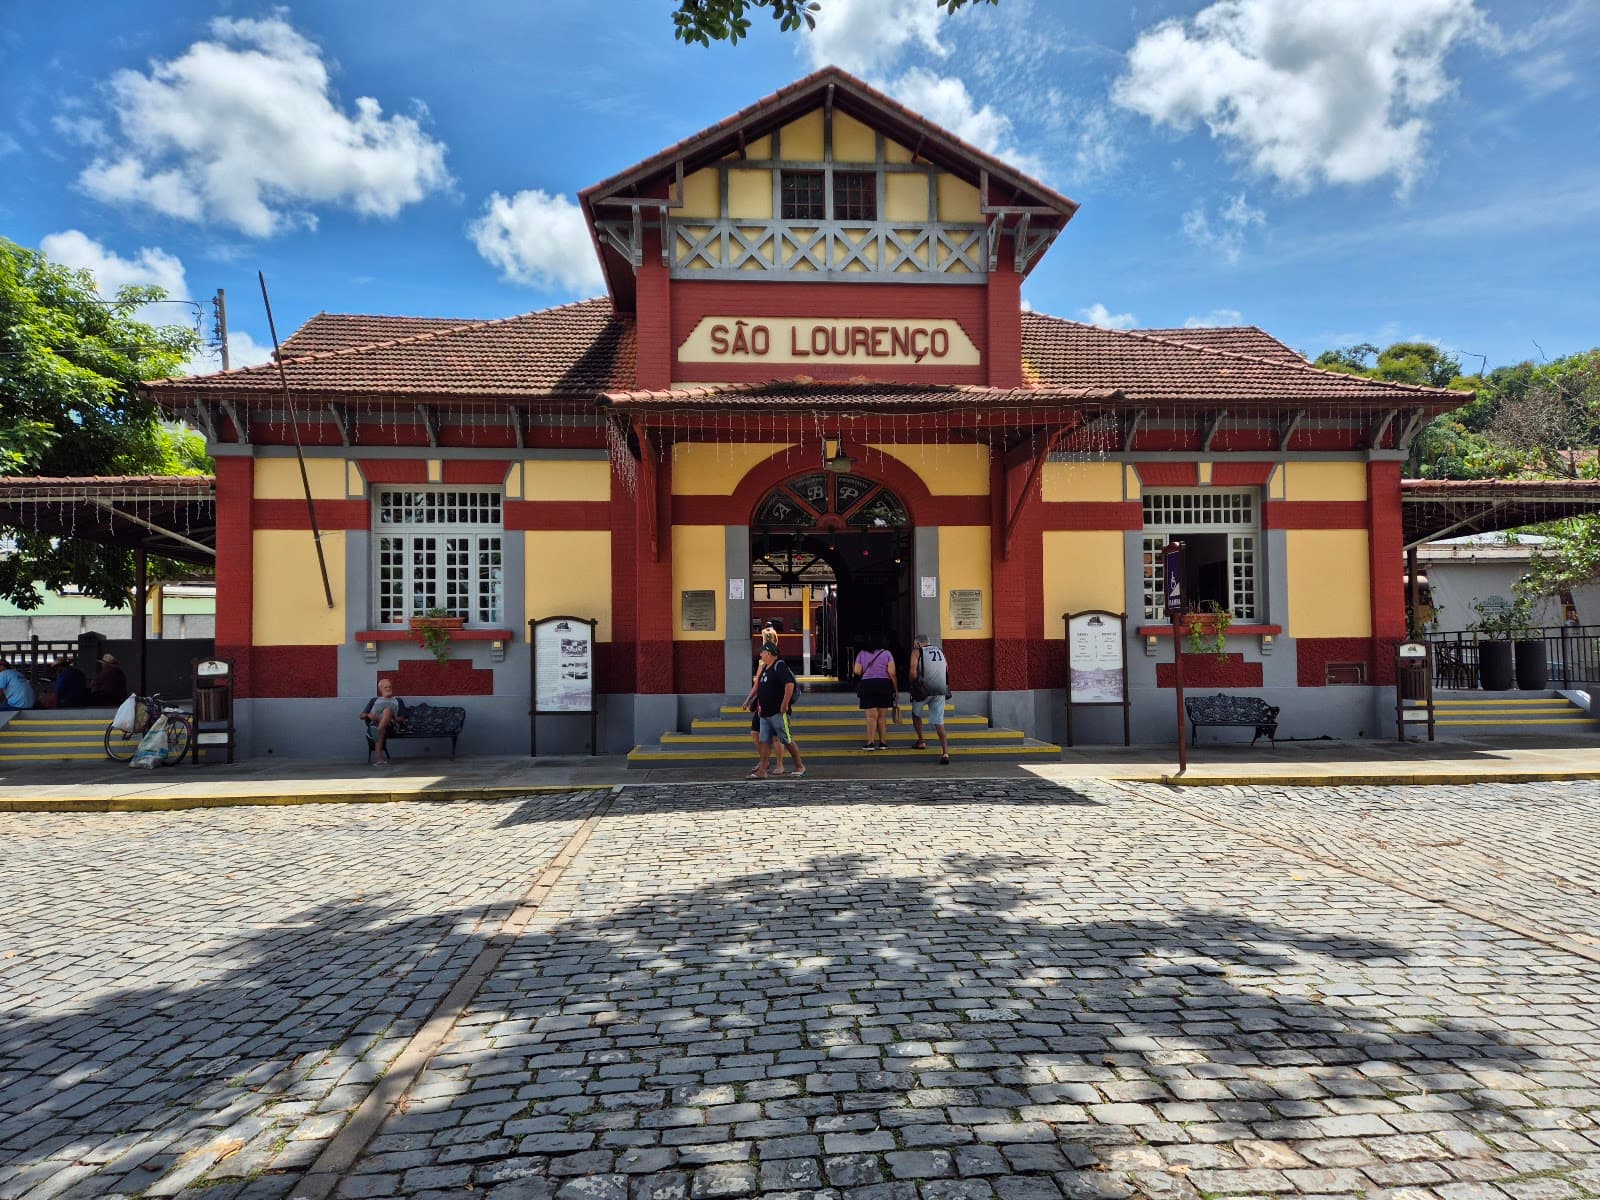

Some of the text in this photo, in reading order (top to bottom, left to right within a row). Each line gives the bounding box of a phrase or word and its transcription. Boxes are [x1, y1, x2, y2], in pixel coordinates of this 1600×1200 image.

[710, 320, 949, 364] SÃO LOURENÇO
[808, 486, 824, 501] B
[839, 487, 859, 499] P
